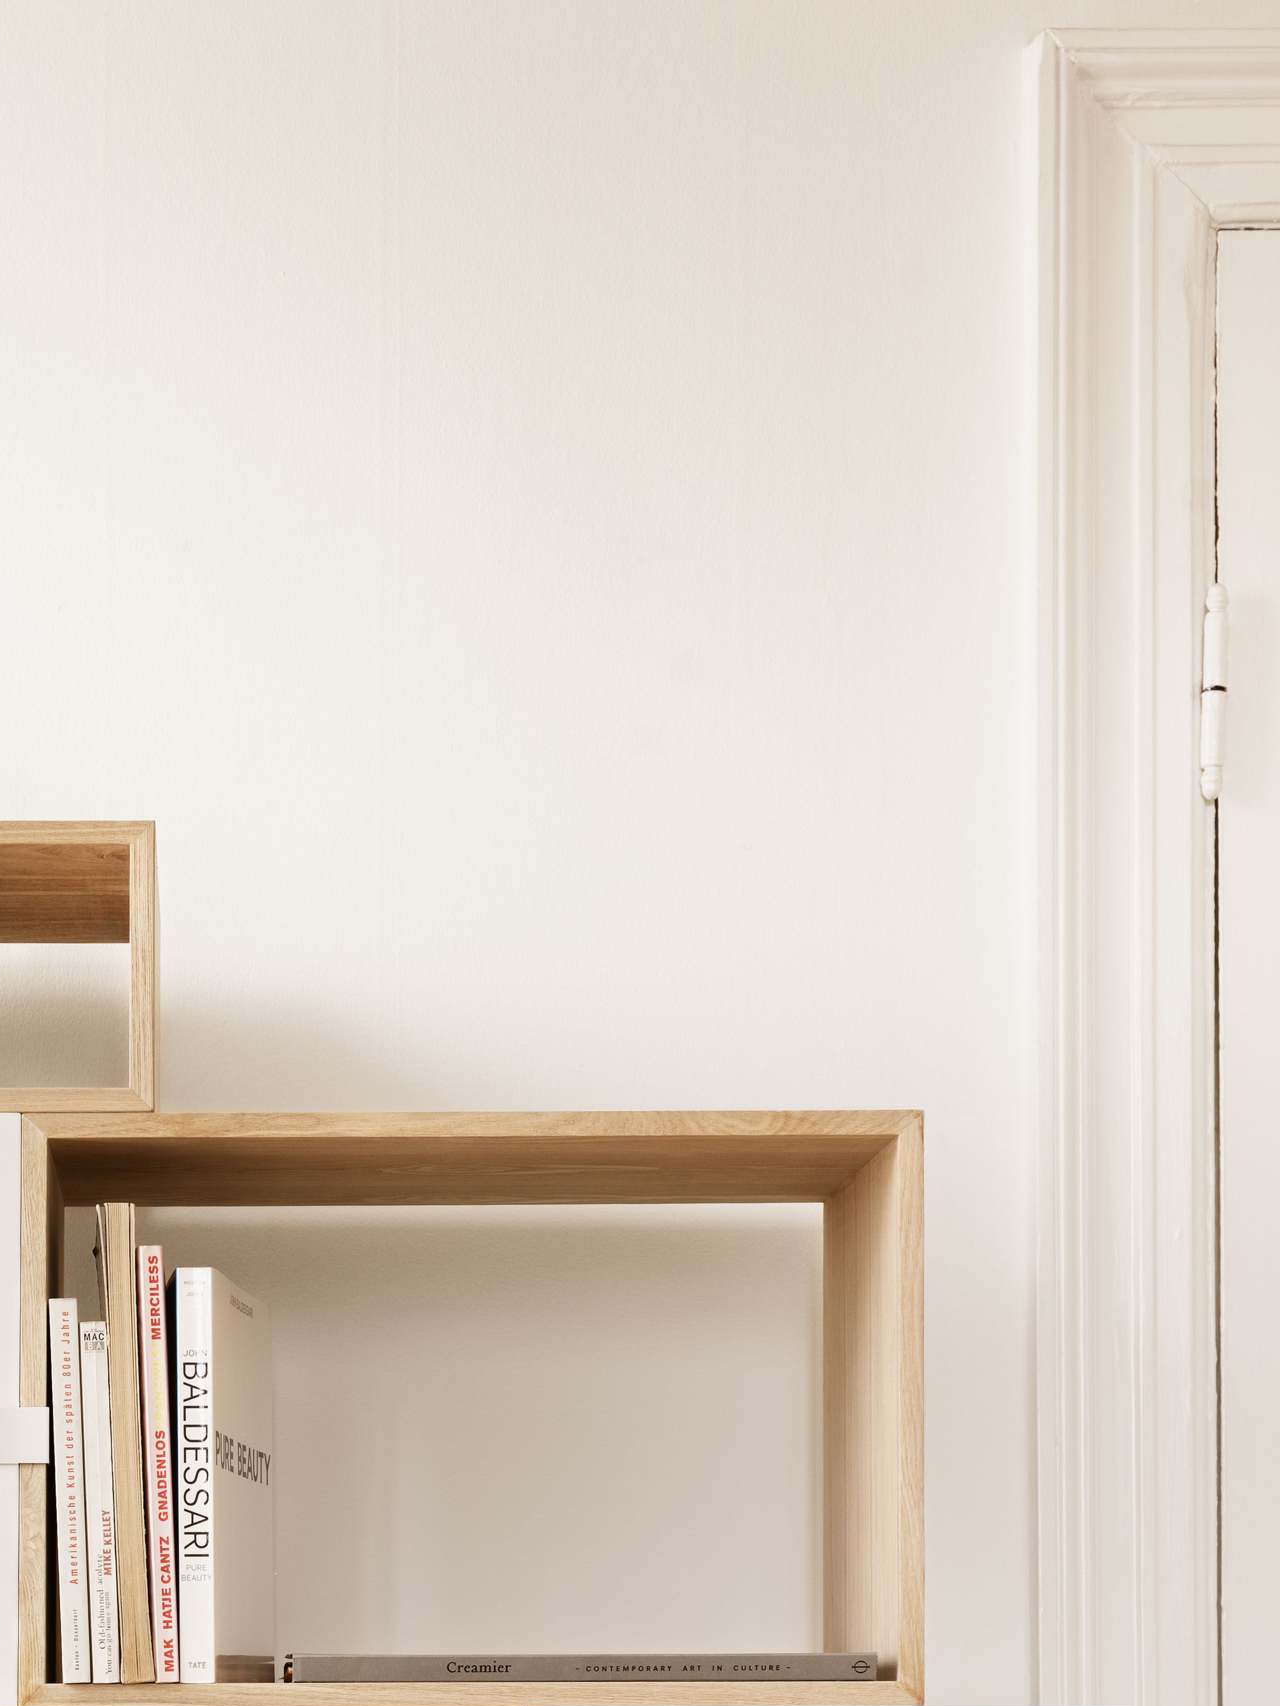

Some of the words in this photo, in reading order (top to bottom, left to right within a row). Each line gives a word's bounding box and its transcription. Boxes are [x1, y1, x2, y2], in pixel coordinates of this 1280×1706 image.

[148, 1255, 161, 1340] MERCILESS
[61, 1311, 70, 1345] Jahre
[84, 1333, 105, 1341] MAC
[62, 1350, 71, 1377] 80er
[183, 1349, 207, 1357] JOHN
[65, 1430, 74, 1449] der
[66, 1456, 75, 1488] Kunst
[183, 1362, 209, 1557] BALDESSARI
[215, 1430, 234, 1473] PURE
[237, 1442, 271, 1486] BEAUTY
[155, 1430, 169, 1522] GNADENLOS
[67, 1495, 78, 1584] Amerikanische
[101, 1510, 112, 1546] KELLEY
[103, 1548, 112, 1576] MIKE
[159, 1536, 171, 1584] CANTZ
[185, 1564, 207, 1572] PURE
[181, 1574, 212, 1582] BEAUTY
[161, 1587, 172, 1629] HATJE
[164, 1638, 175, 1672] MAK
[447, 1661, 512, 1673] Creamier
